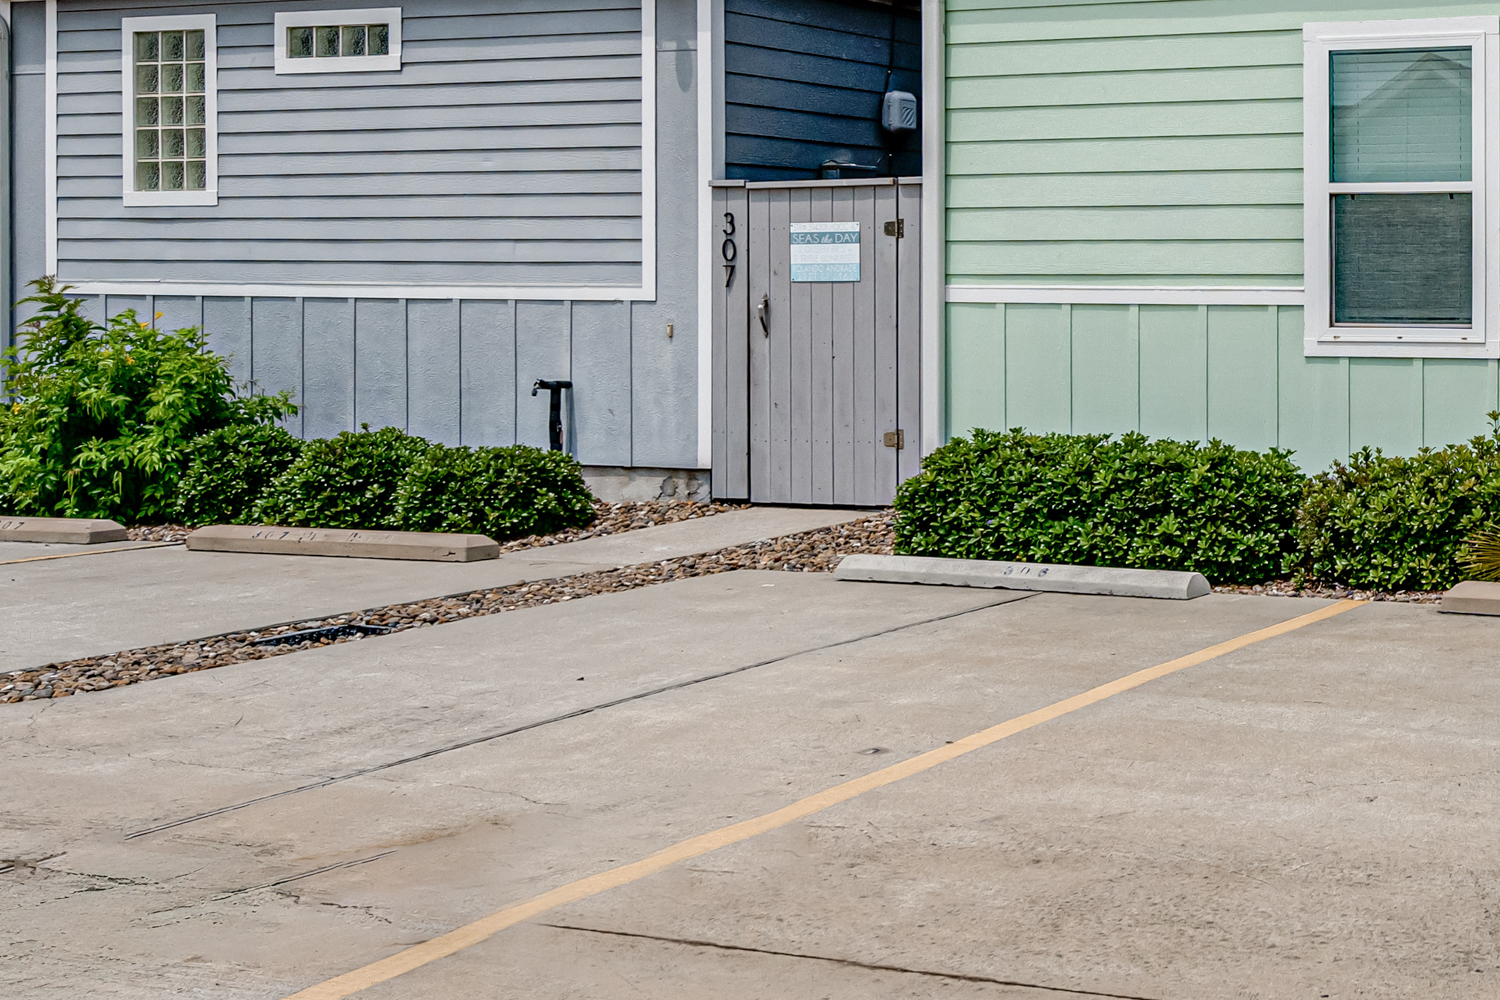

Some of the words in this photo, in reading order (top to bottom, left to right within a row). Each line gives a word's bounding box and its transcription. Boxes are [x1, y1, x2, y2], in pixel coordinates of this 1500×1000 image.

[792, 233, 820, 244] SEAS
[821, 234, 833, 244] the
[835, 233, 858, 243] DAY
[722, 212, 738, 288] 307
[0, 520, 25, 530] 07
